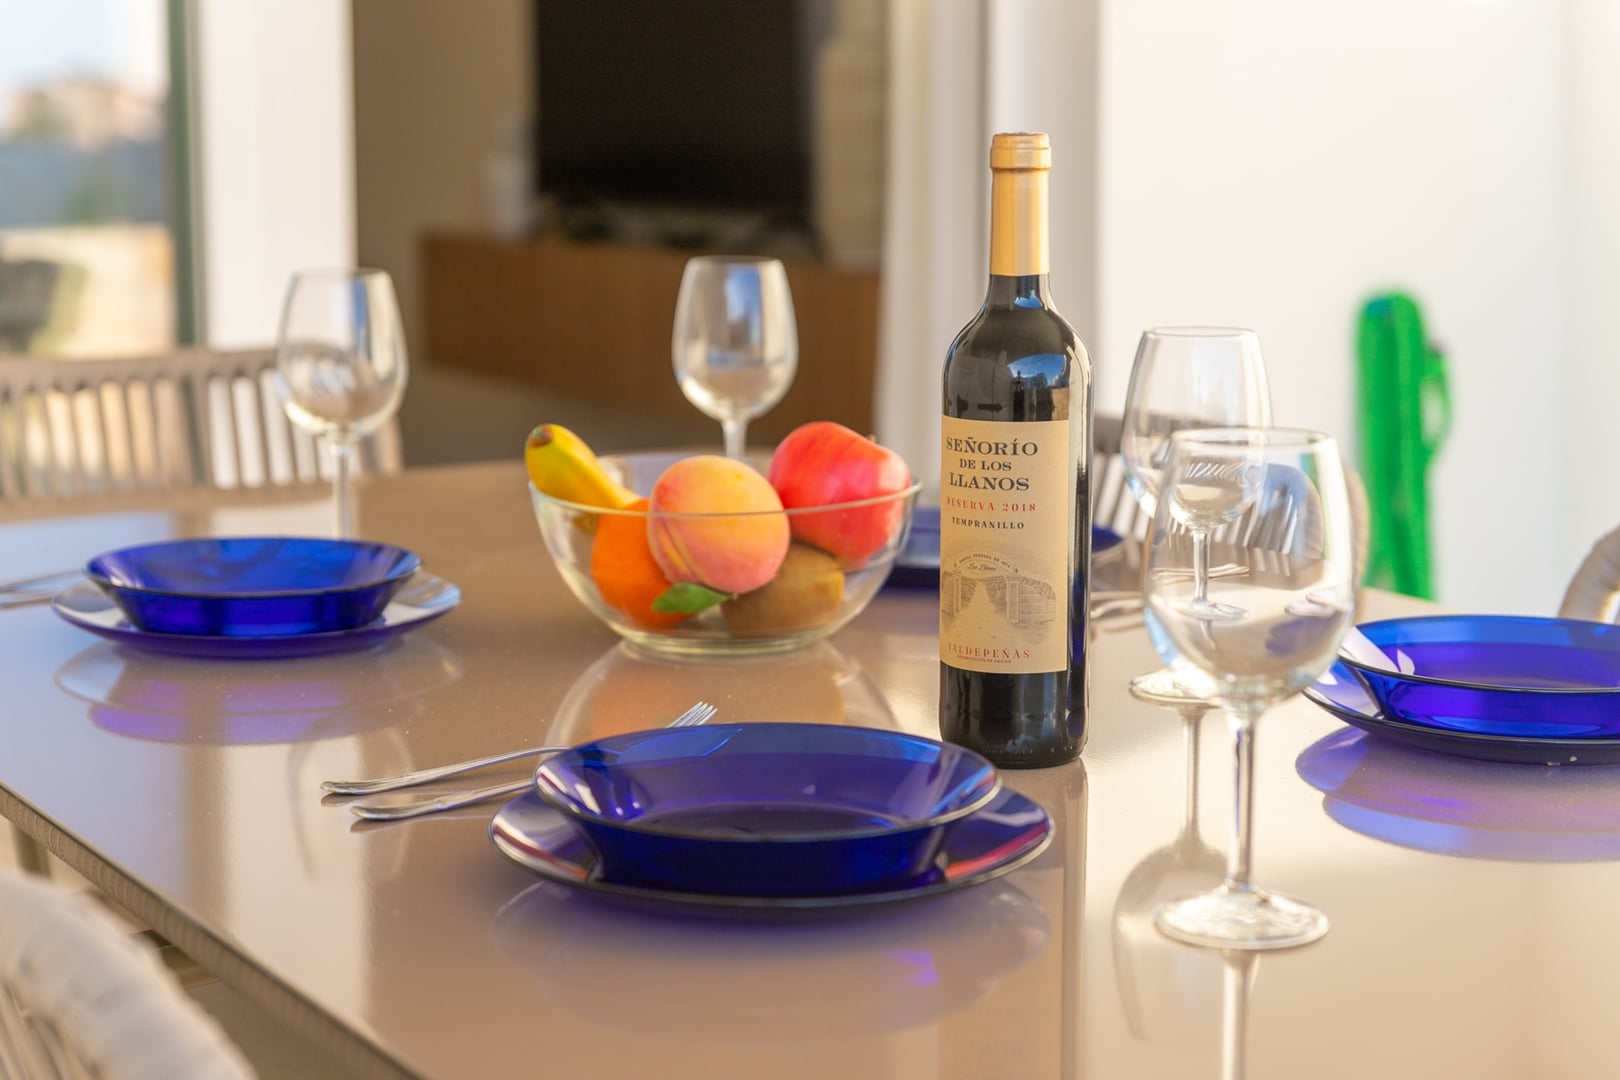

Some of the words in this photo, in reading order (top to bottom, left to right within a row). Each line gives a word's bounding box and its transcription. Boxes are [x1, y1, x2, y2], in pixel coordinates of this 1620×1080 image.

[946, 436, 1038, 456] SEÑORÍO
[959, 458, 976, 469] DE
[981, 461, 1012, 471] LOS
[949, 472, 1029, 491] LLANOS
[947, 496, 995, 511] RESERVA
[1002, 503, 1036, 512] 2018
[952, 516, 1024, 529] TEMPRANILLO
[948, 642, 1030, 659] VALDEPEÑAS
